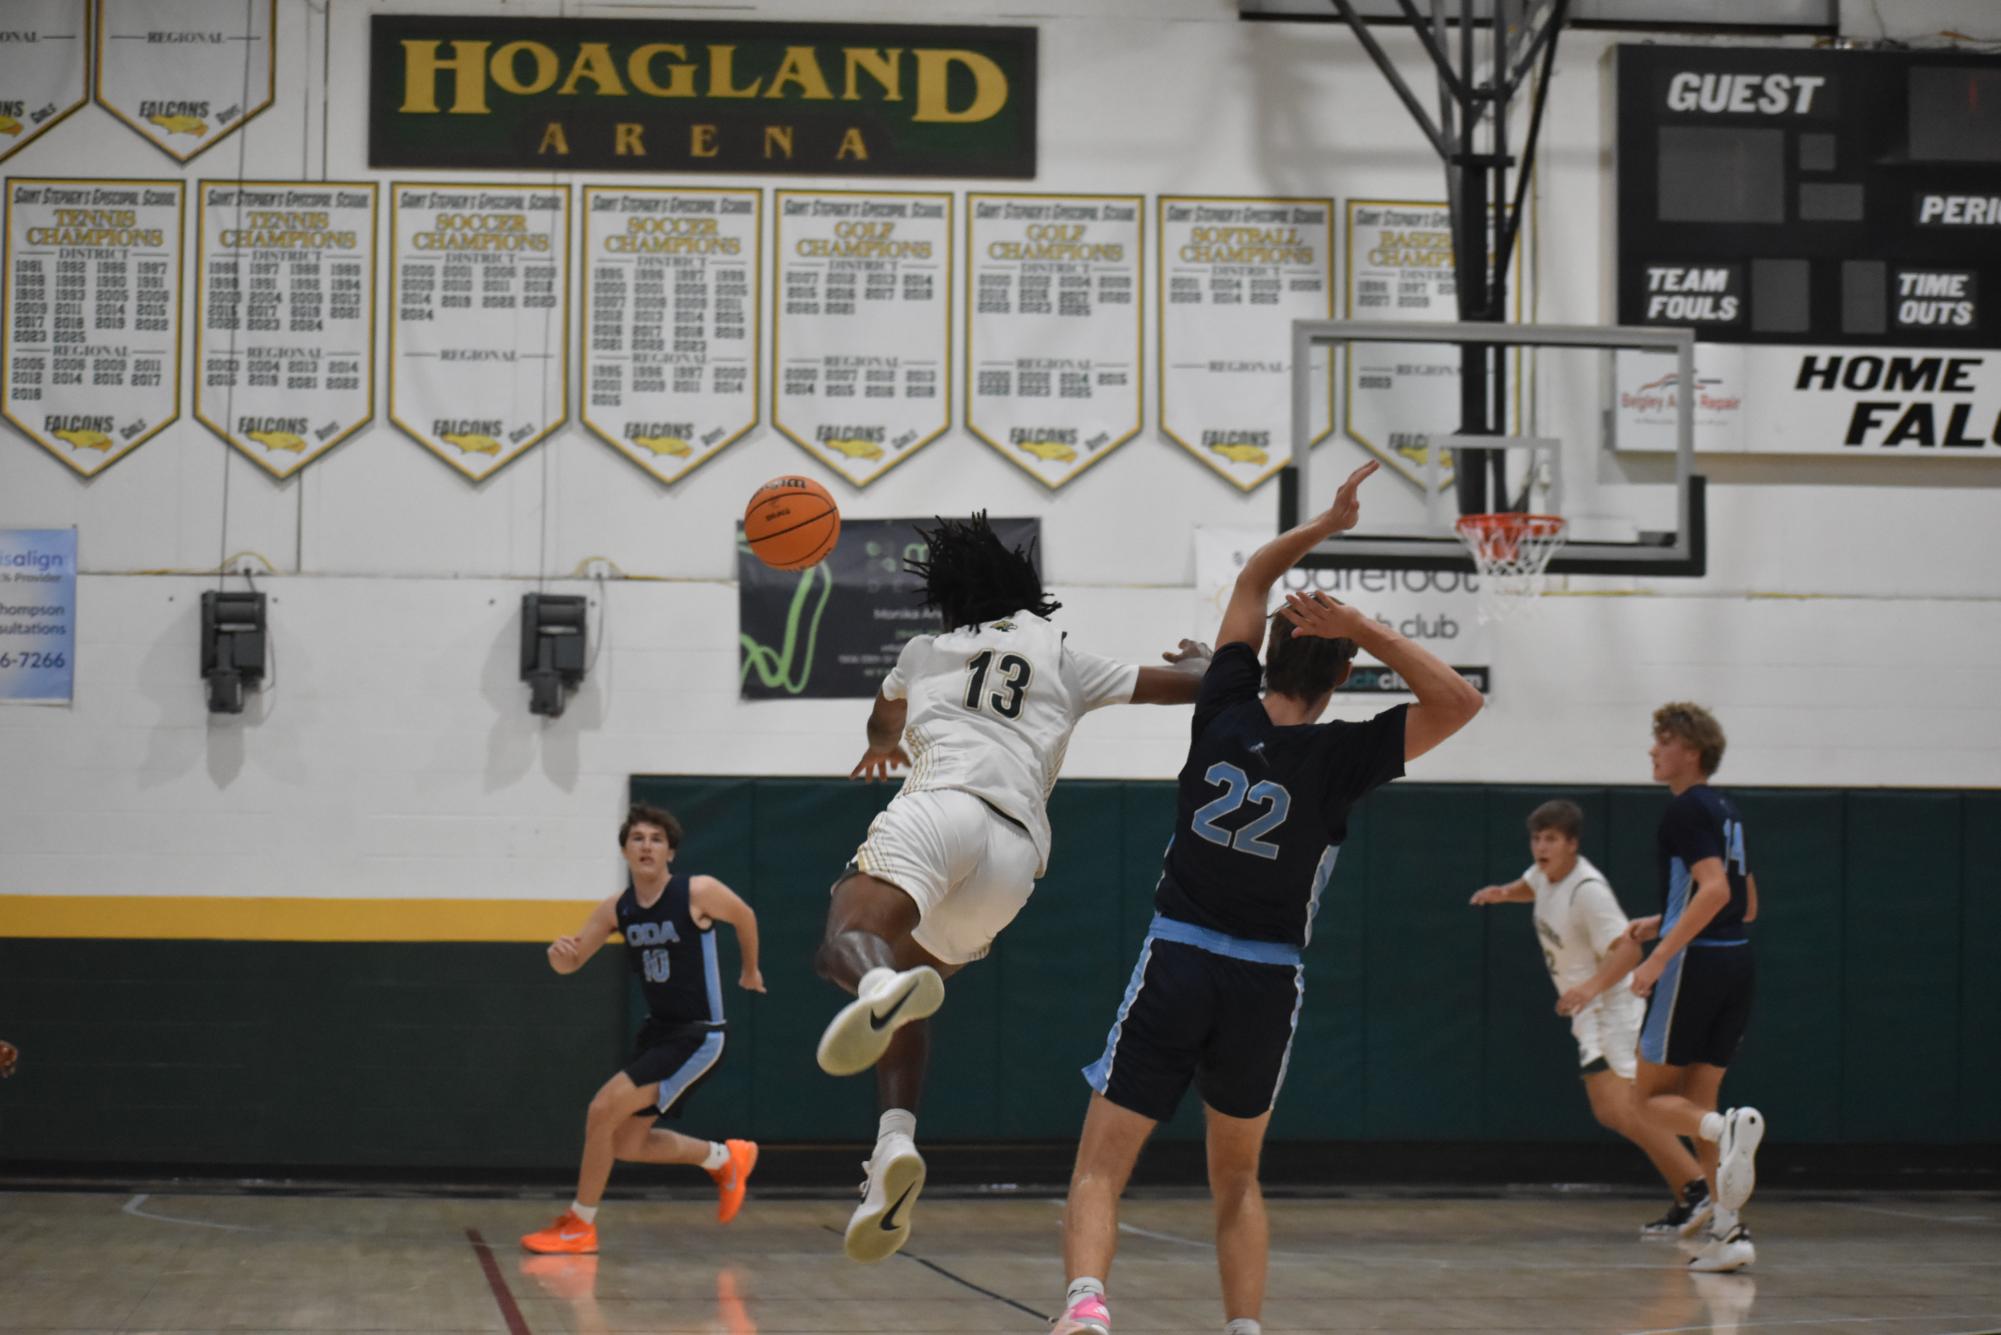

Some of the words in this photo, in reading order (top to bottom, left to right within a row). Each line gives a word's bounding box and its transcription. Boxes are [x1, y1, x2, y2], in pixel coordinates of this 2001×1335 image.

[147, 32, 225, 44] REGIONAL
[399, 39, 1009, 123] HOAGLAND
[1667, 72, 1826, 115] GUEST
[140, 102, 209, 117] FALCONS
[538, 122, 869, 161] ARENA
[53, 209, 136, 228] TENNIS
[247, 211, 329, 230] TENNIS
[435, 213, 527, 232] SOCCER
[26, 227, 164, 247] CHAMPIONS
[219, 229, 357, 249] CHAMPIONS
[412, 232, 550, 252] CHAMPIONS
[604, 235, 741, 255] CHAMPIONS
[59, 249, 128, 260] DISTRICT
[795, 239, 932, 259] CHAMPIONS
[988, 242, 1124, 262] CHAMPIONS
[1646, 267, 1730, 293] TEAM
[1899, 273, 1969, 298] TIME
[55, 303, 82, 315] 2011
[95, 304, 125, 316] 2014
[1647, 295, 1738, 321] FOULS
[1899, 300, 1973, 326] OUTS
[15, 317, 44, 329] 2017
[14, 330, 47, 343] 2023
[53, 346, 128, 357] REGIONAL
[134, 359, 161, 372] 2011
[1794, 355, 1984, 392] HOME
[52, 373, 82, 385] 2014
[131, 374, 161, 386] 2017
[44, 415, 114, 432] FALCONS
[238, 416, 308, 434] FALCONS
[433, 420, 503, 437] FALCONS
[624, 422, 694, 440] FALCONS
[1844, 401, 2001, 449] FAL
[816, 425, 886, 443] FALCONS
[1010, 427, 1078, 445] FALCONS
[1202, 430, 1270, 447] FALCONS
[1399, 613, 1459, 639] club
[963, 648, 1034, 720] 13
[1191, 761, 1291, 860] 22
[642, 949, 671, 983] 10
